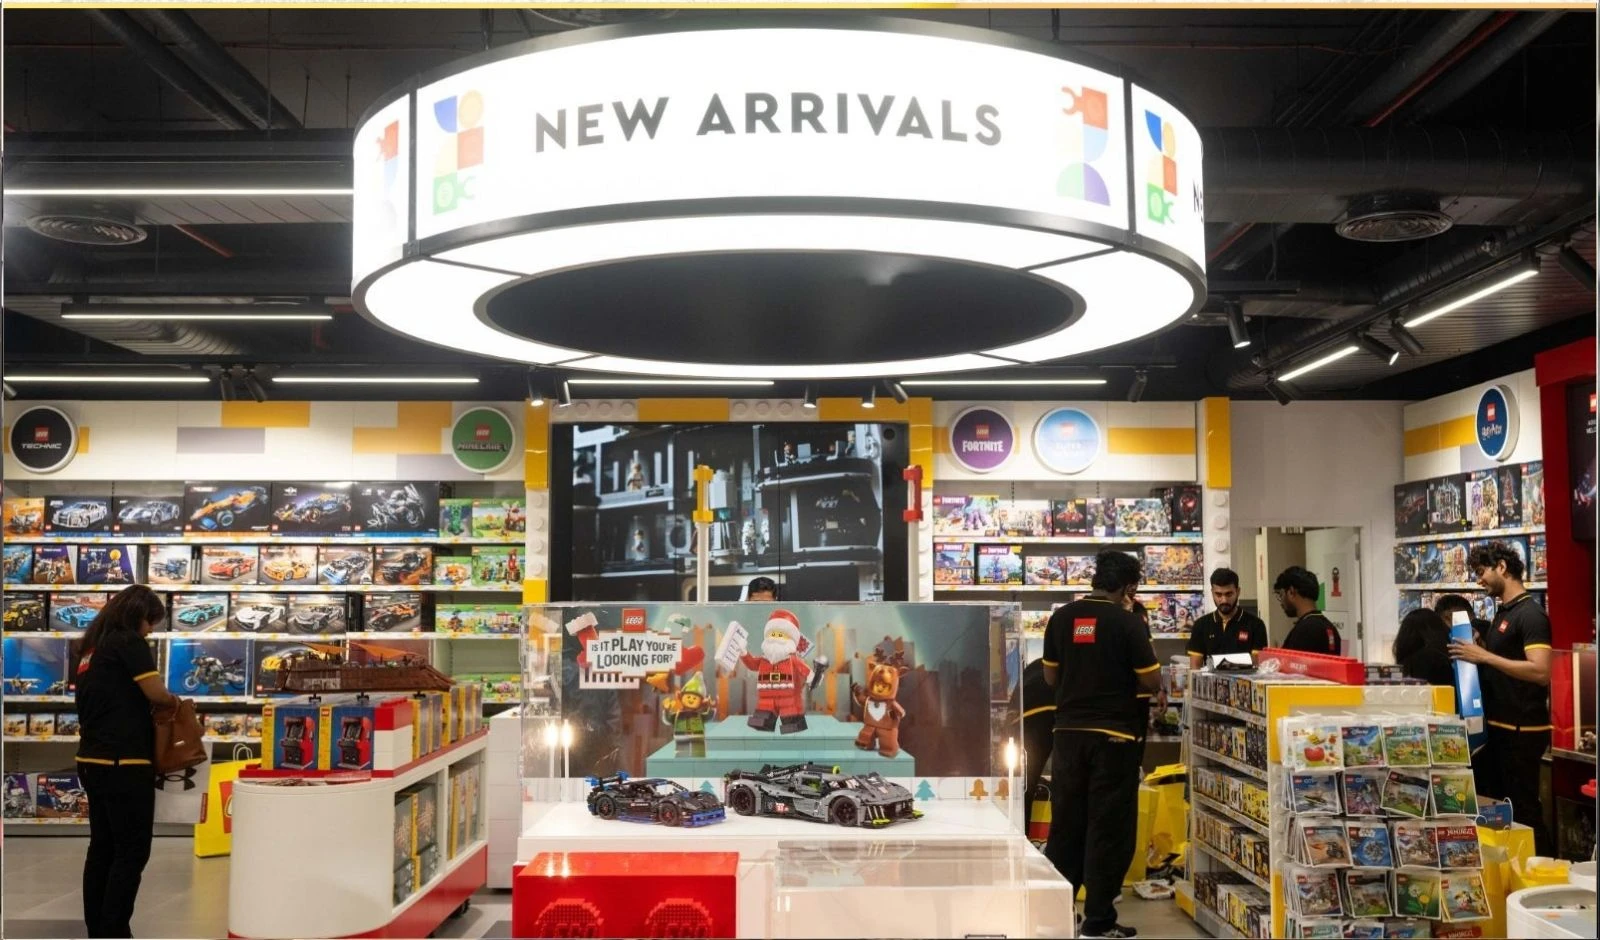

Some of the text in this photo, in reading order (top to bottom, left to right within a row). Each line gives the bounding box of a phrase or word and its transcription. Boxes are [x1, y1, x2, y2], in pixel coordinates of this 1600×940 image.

[535, 92, 1002, 153] NEW ARRIVALS
[962, 440, 1004, 453] FORTNITE
[625, 616, 643, 625] LEGO
[1073, 625, 1096, 636] LEGO
[591, 636, 677, 652] IS IT PLAY YOU'RE
[597, 653, 673, 669] LOOKING FOR?
